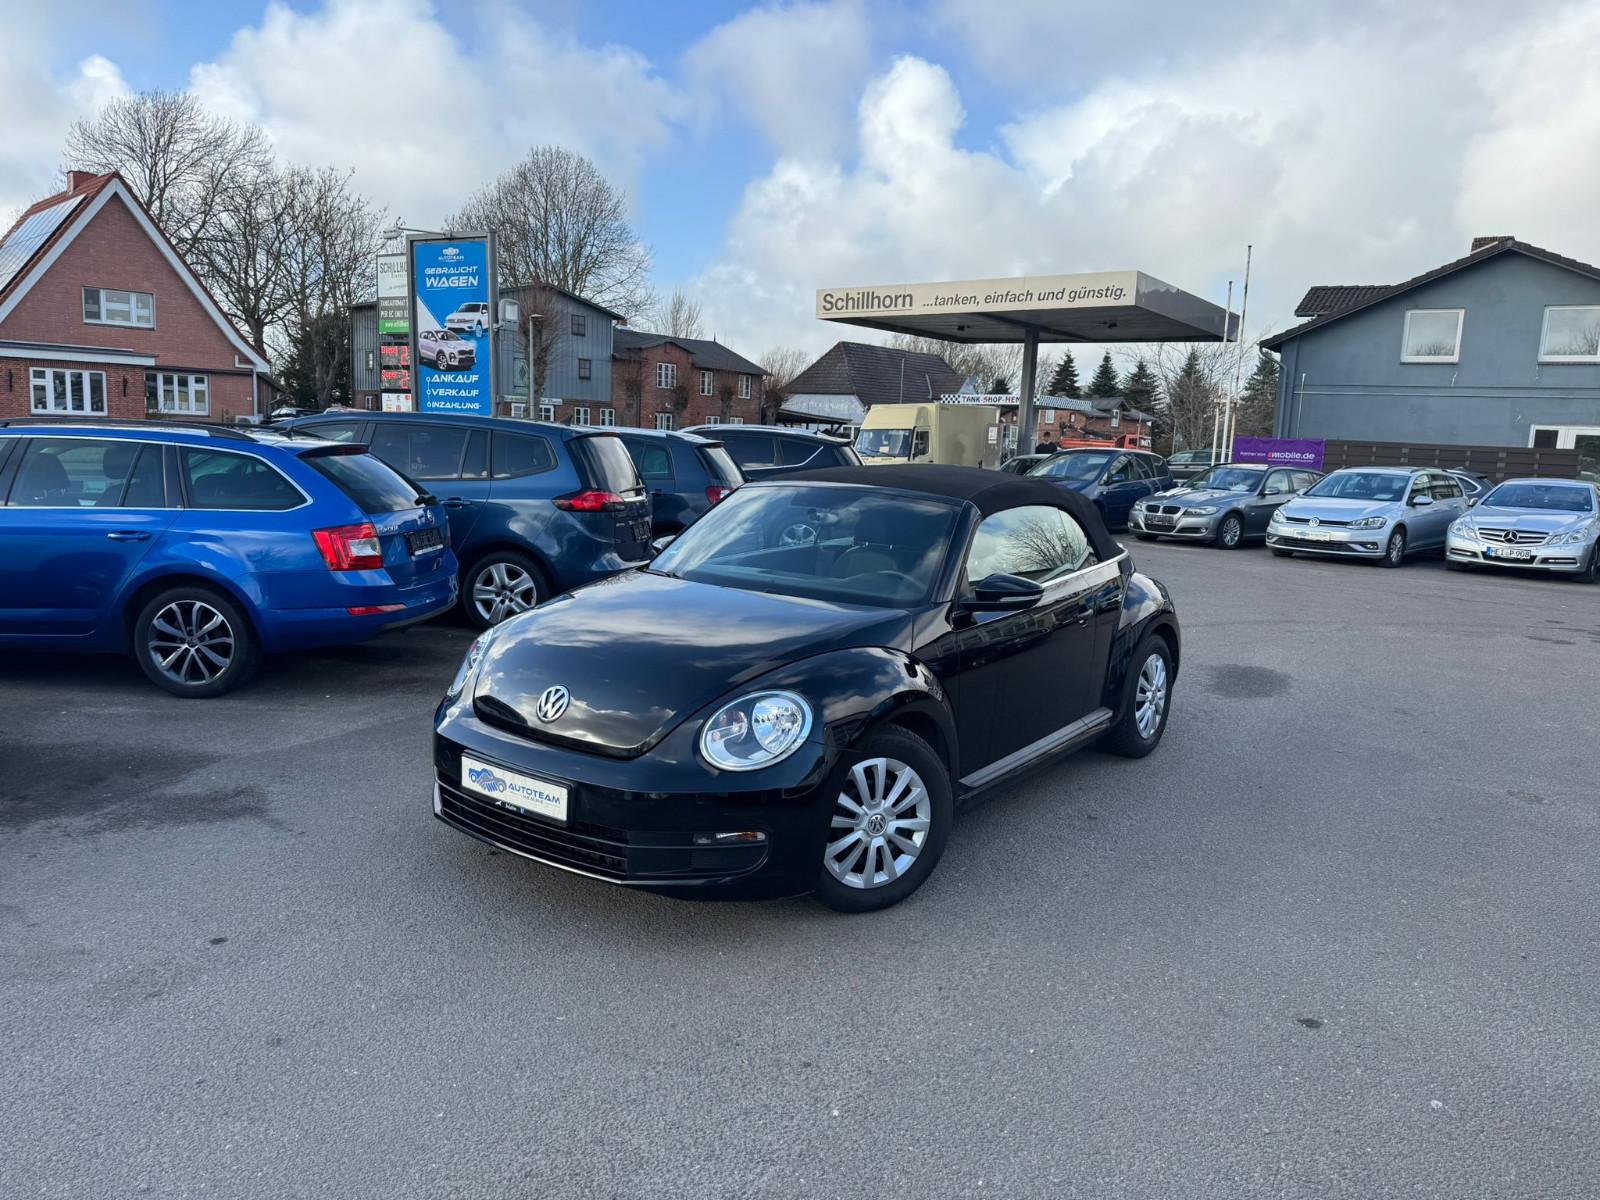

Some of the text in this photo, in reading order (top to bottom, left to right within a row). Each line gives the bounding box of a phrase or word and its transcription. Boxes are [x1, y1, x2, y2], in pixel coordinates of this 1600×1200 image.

[424, 265, 479, 275] GEBRAUCHT
[425, 275, 479, 288] WAGEN
[822, 290, 914, 312] Schillhorn
[984, 289, 1033, 304] einfach
[1037, 287, 1066, 302] und
[1067, 284, 1127, 303] günstig.
[431, 373, 480, 384] ANKAUF
[431, 388, 480, 397] VERKAUF
[1271, 451, 1316, 460] mobile.de
[508, 782, 561, 805] AUTOTEAM
